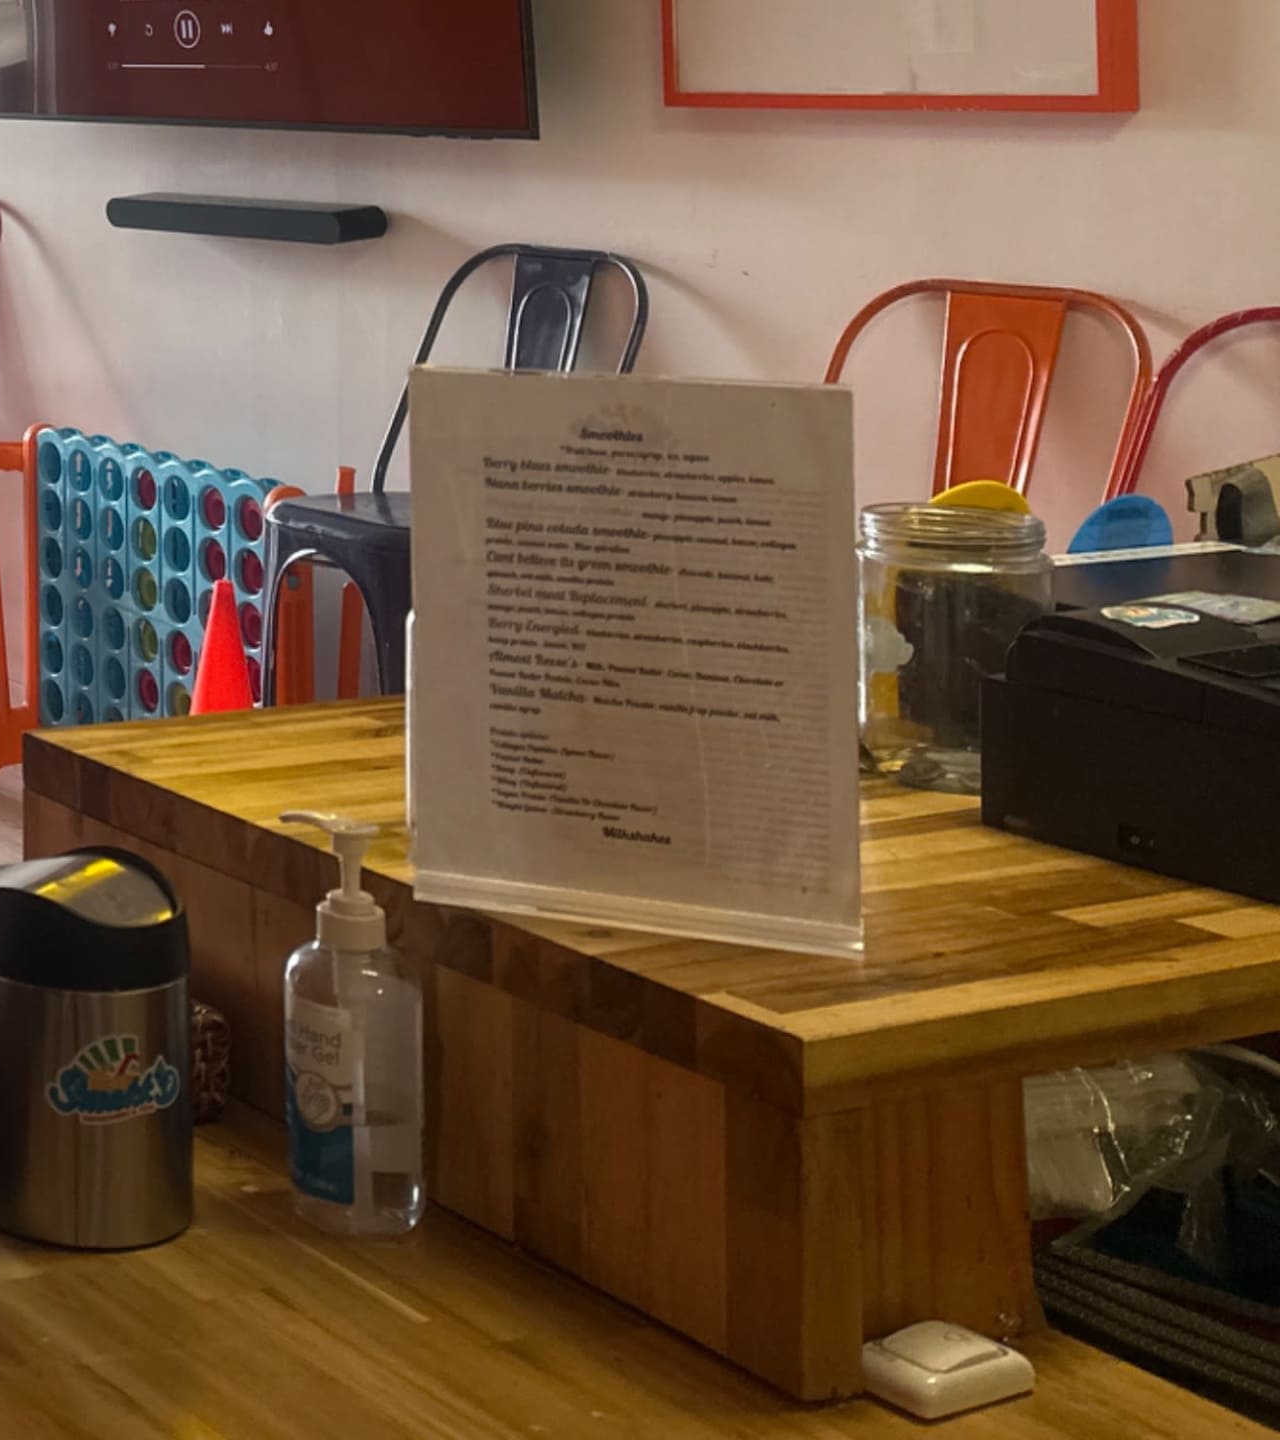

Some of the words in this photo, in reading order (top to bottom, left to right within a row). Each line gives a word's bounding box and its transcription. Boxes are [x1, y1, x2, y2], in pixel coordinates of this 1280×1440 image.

[580, 427, 643, 442] Smoothies
[483, 457, 517, 473] Berry
[521, 479, 563, 493] berries
[486, 517, 513, 531] Blue
[546, 523, 590, 536] colada
[517, 552, 557, 567] believe
[577, 560, 613, 572] green
[568, 590, 647, 607] Replacement
[488, 617, 522, 634] Berry
[489, 650, 532, 665] Almost
[490, 683, 536, 699] Vanilla
[603, 826, 672, 846] Milkshakes
